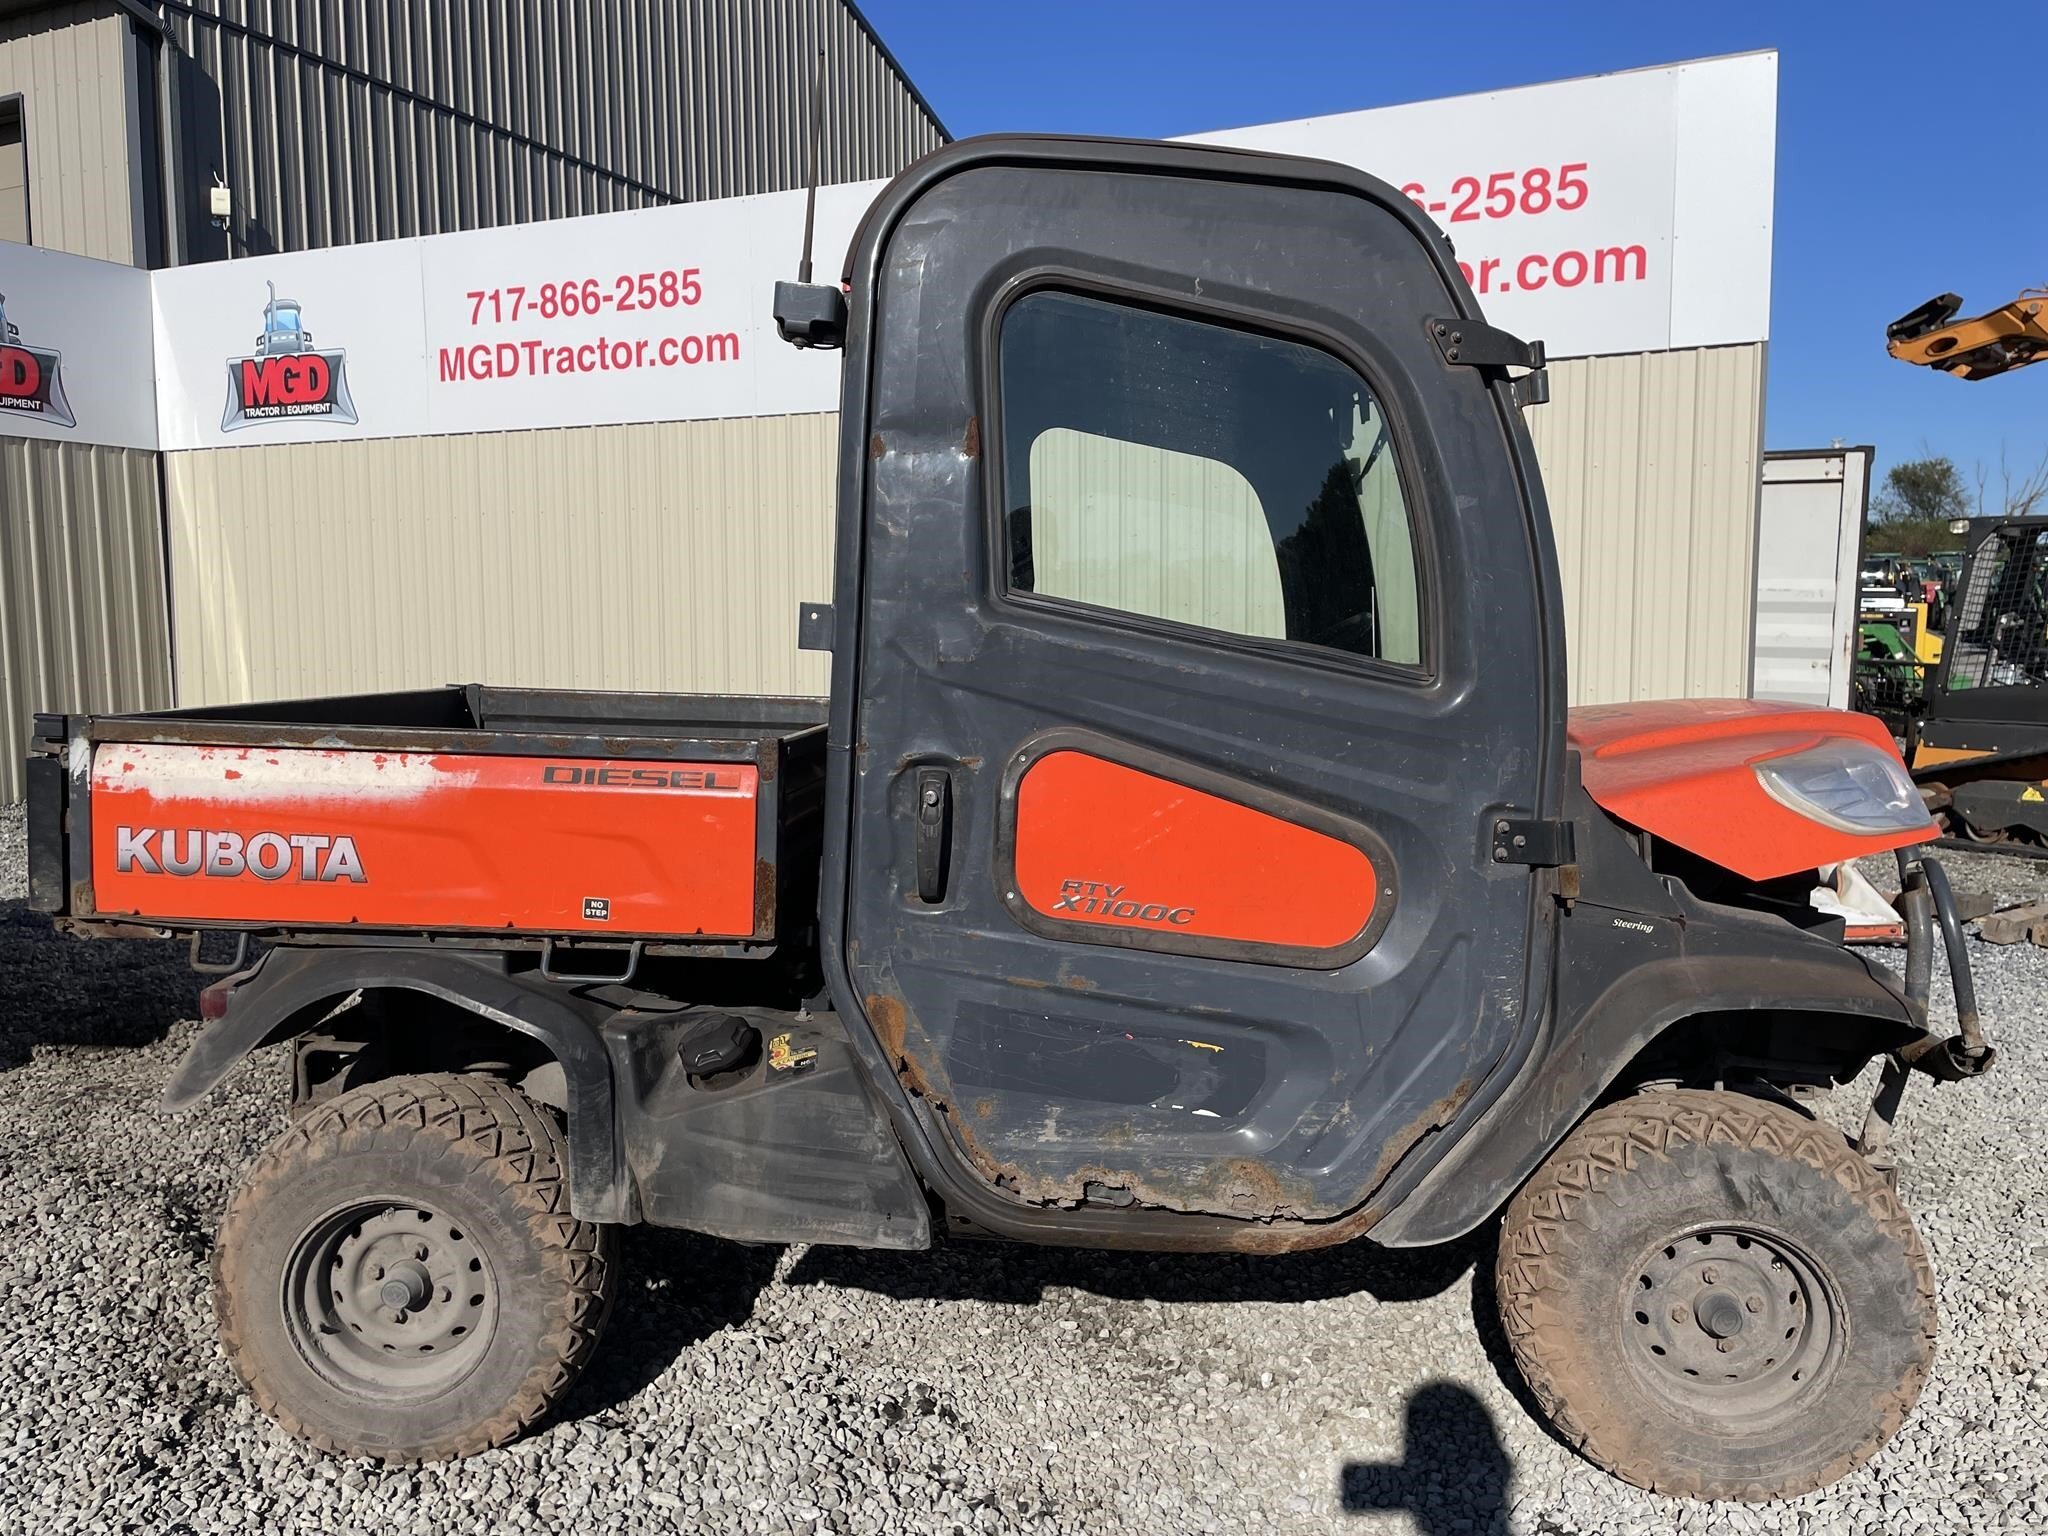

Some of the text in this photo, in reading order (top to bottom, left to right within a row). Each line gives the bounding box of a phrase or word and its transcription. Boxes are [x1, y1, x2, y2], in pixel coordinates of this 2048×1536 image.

[466, 267, 703, 326] 717-866-2585
[439, 331, 741, 382] MGDTractor.com
[241, 353, 331, 407] MGD
[245, 406, 280, 417] TRACTOR
[287, 402, 331, 414] EQUIPMENT
[543, 765, 739, 790] DIESEL
[116, 826, 368, 883] KUBOTA
[1061, 879, 1125, 897] RTV
[585, 908, 607, 916] STEP
[591, 900, 603, 908] NO
[1052, 893, 1196, 925] X1100C
[1612, 918, 1654, 933] Steering
